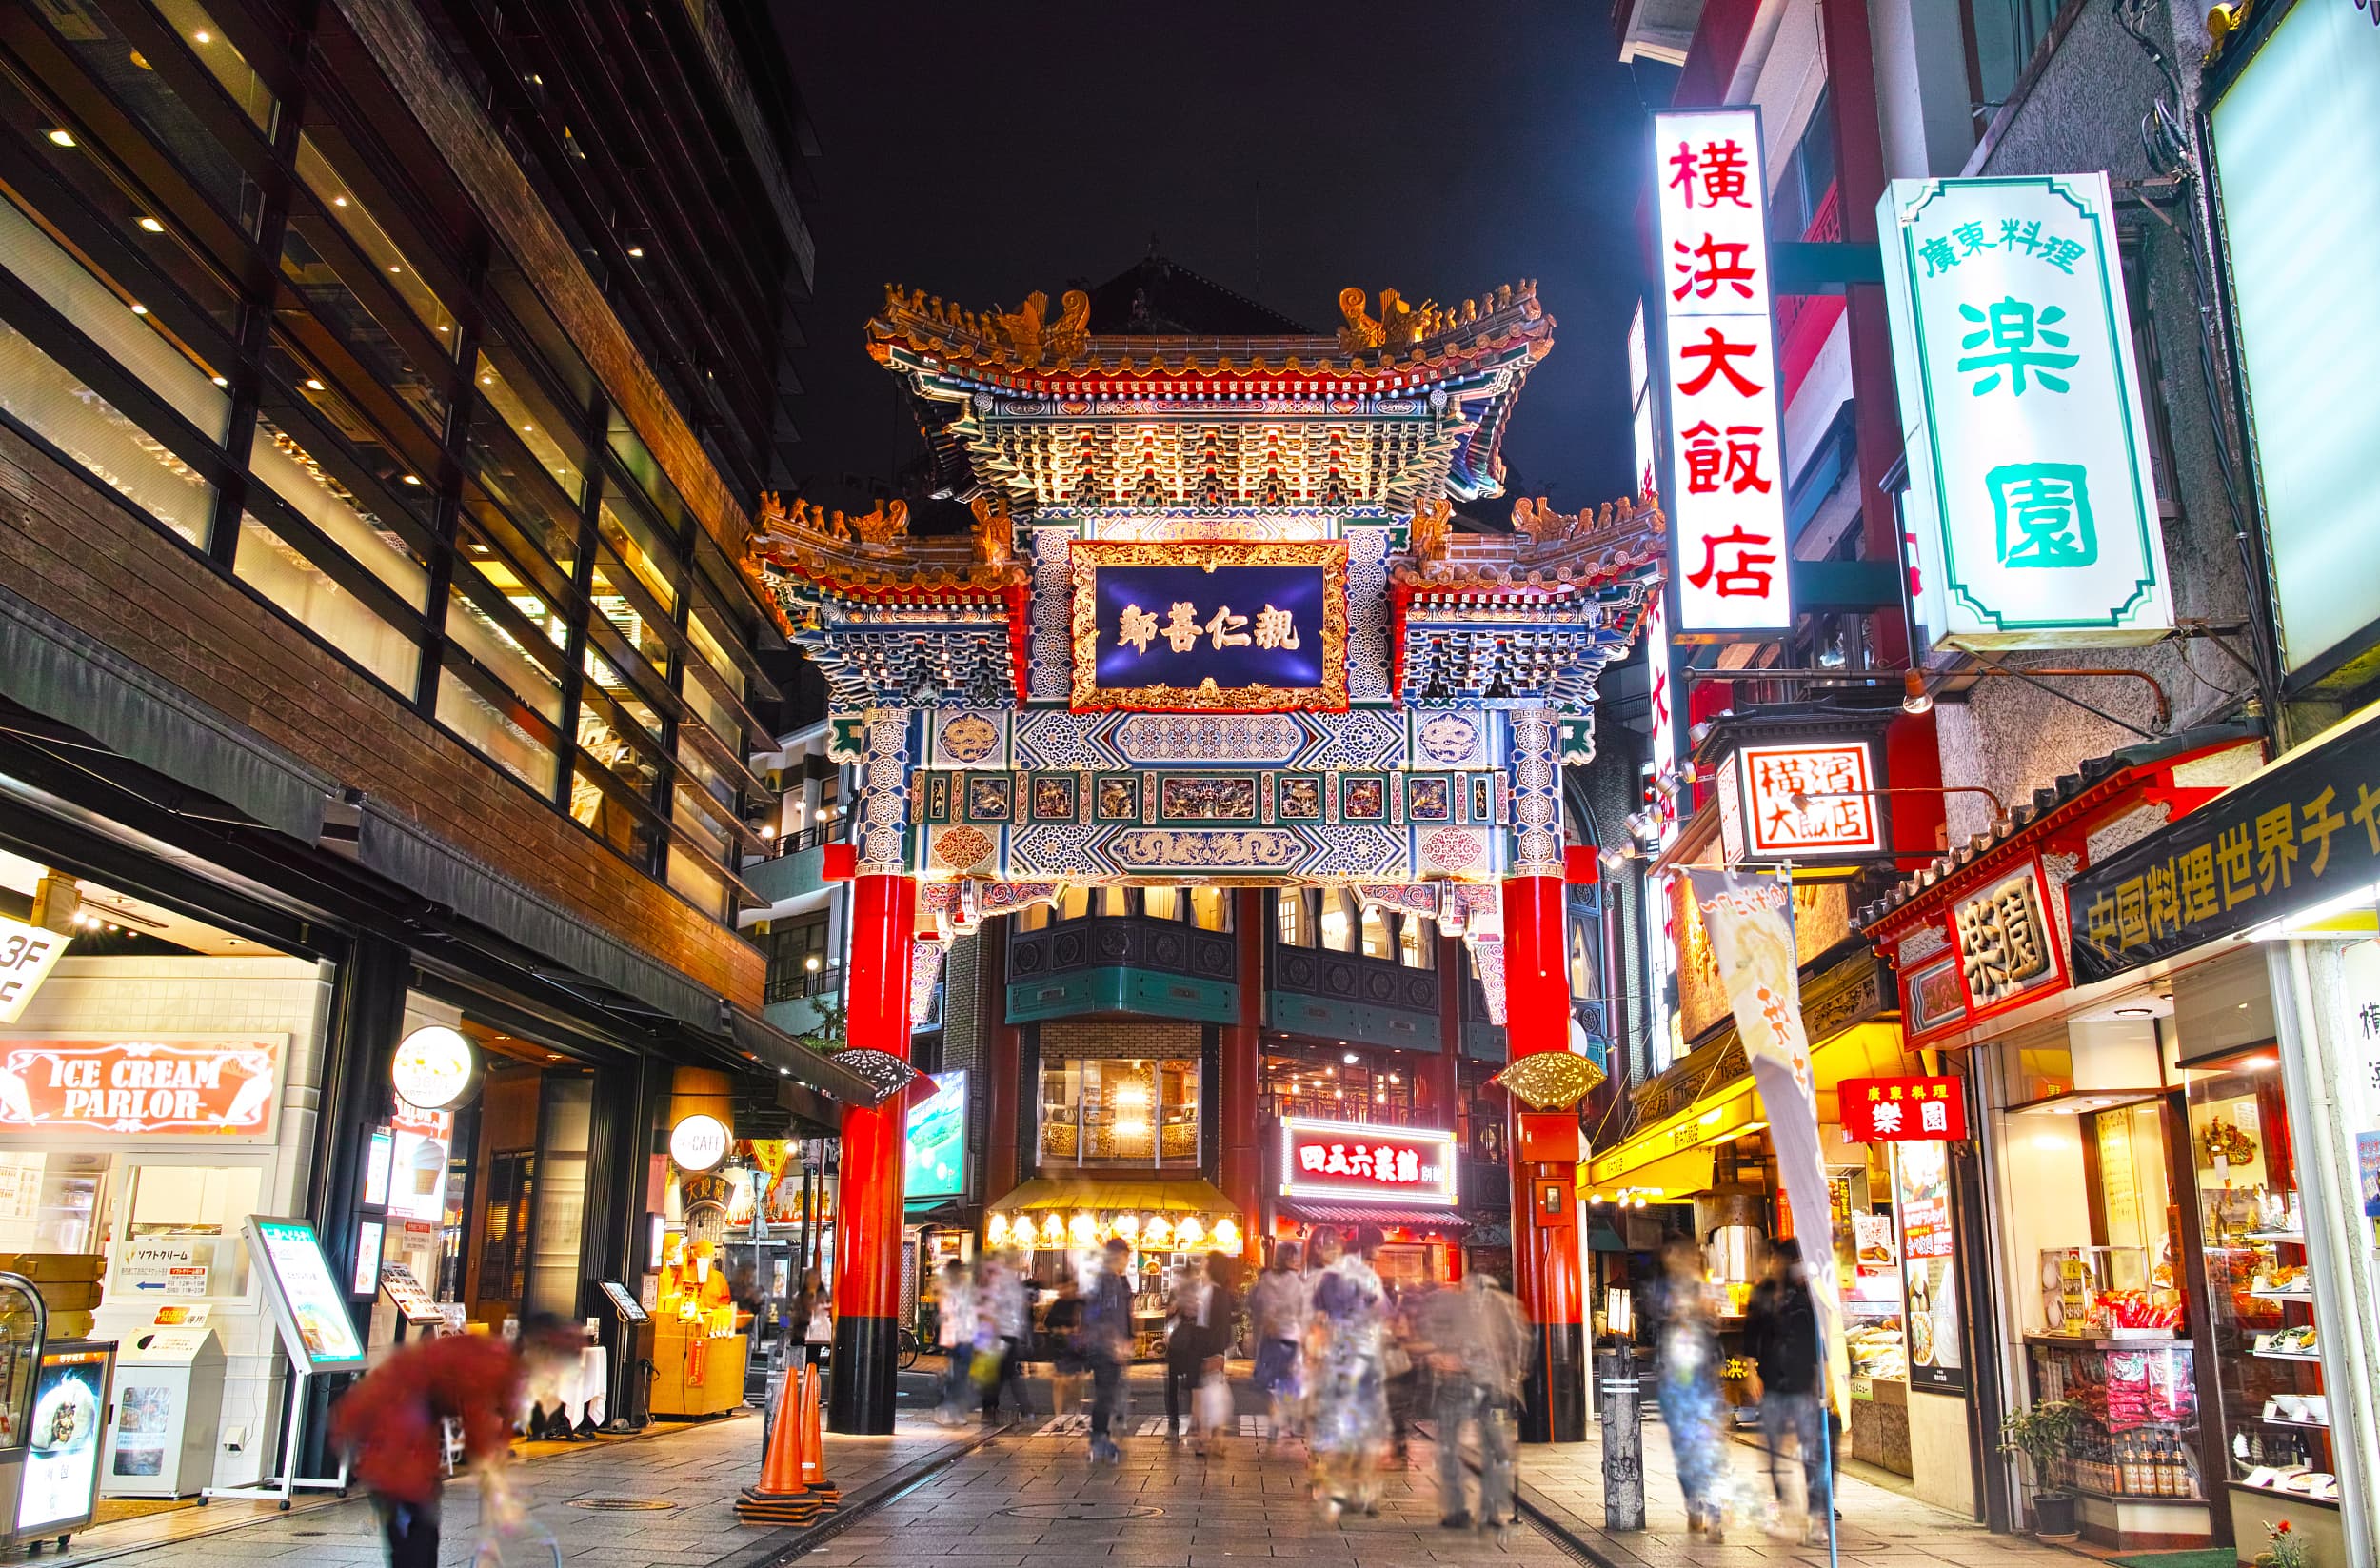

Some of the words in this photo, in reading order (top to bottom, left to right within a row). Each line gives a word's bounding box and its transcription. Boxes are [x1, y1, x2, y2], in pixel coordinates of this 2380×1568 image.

[1918, 218, 2086, 278] 廣東料理
[1669, 139, 1776, 598] 横浜大飯店
[1958, 296, 2098, 568] 楽園
[49, 1059, 102, 1088] ICE
[111, 1059, 221, 1089] CREAM
[63, 1089, 208, 1120] PARLOR
[1868, 1085, 1949, 1101] 廣東料理
[1300, 1144, 1419, 1182] 四五六菜館
[138, 1249, 188, 1260] ソフトクリーム
